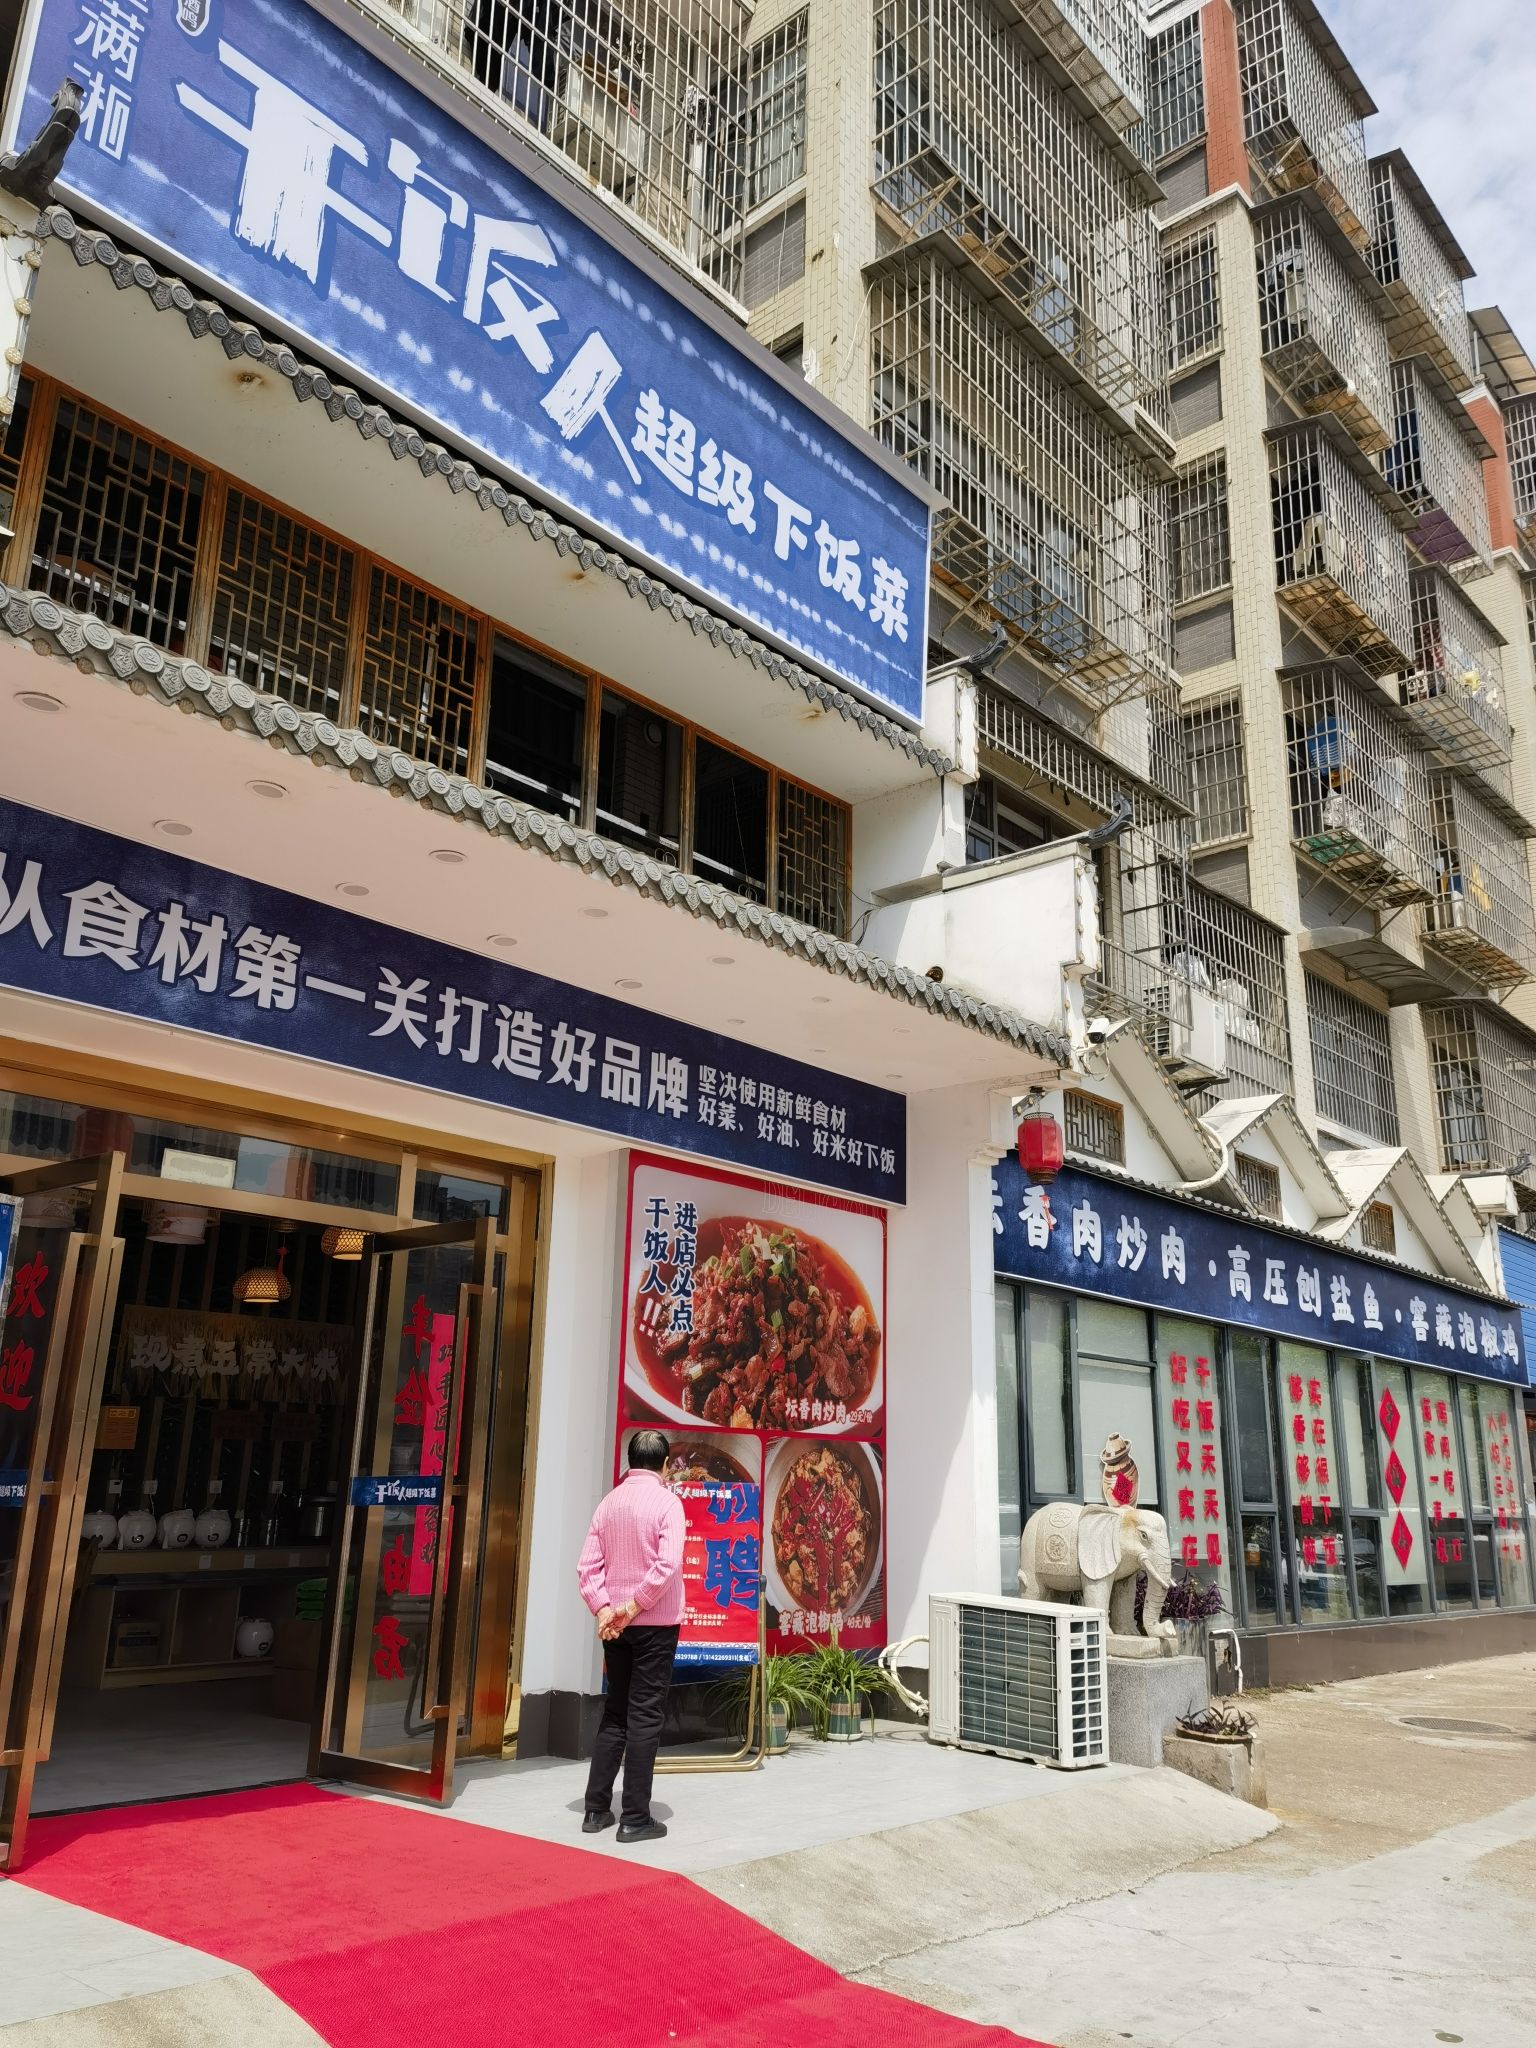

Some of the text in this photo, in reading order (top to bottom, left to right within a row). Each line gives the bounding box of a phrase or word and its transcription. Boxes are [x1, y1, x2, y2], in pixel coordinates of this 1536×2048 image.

[73, 0, 149, 161] 满湘
[631, 389, 909, 643] 超级下饭菜
[0, 851, 689, 1120] 从食材第一关打造好品牌
[698, 1065, 847, 1134] 坚决使用新鲜食材
[698, 1097, 897, 1176] 好菜、好油、好米好下饭
[0, 1251, 49, 1411] 欢迎
[669, 1202, 698, 1334] 进店必点
[785, 1397, 847, 1425] 坛香肉炒肉
[1170, 1352, 1199, 1568] 好吃又实在
[1194, 1356, 1222, 1567] 干饭天天见
